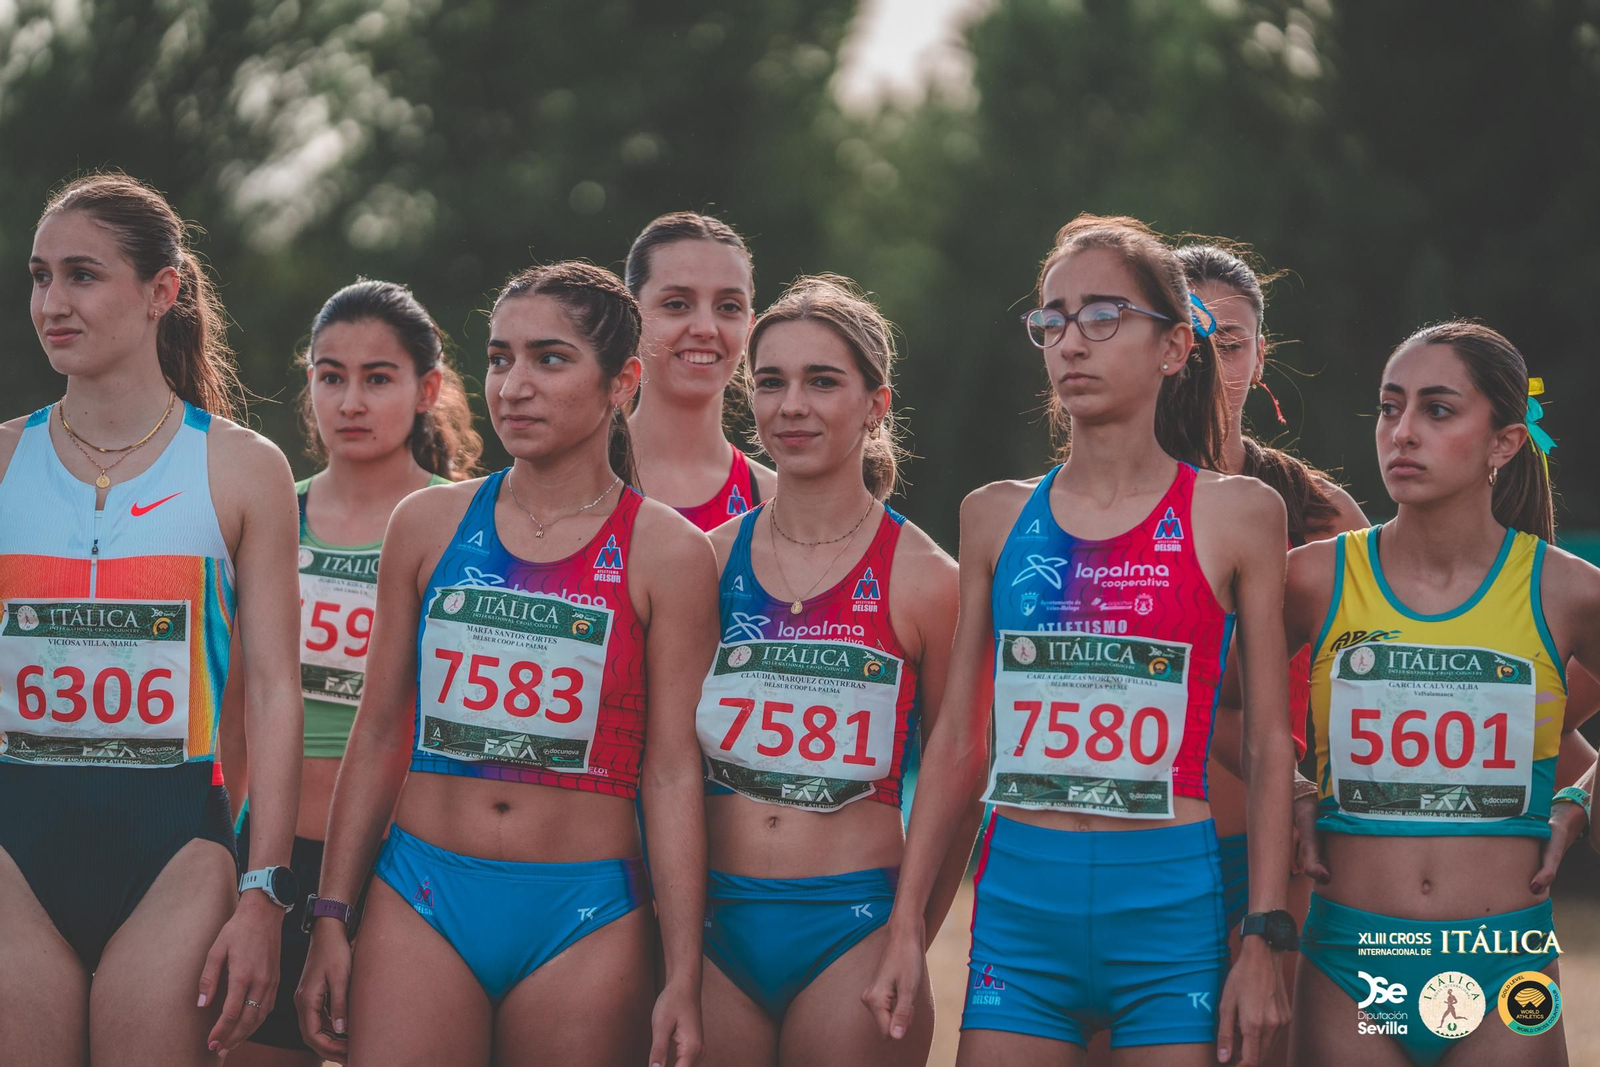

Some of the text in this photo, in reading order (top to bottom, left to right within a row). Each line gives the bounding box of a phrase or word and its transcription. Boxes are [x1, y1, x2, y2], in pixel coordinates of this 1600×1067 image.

[594, 574, 621, 583] DELSUR
[1075, 561, 1170, 584] lapalma
[1101, 578, 1170, 590] cooperativa
[50, 605, 139, 628] ITÁLICA
[475, 594, 559, 624] ITÁLICA
[852, 604, 878, 612] DELSUR
[300, 599, 374, 657] 59
[466, 625, 558, 644] MARTA SANTOS CORTES
[778, 620, 864, 640] lapalma
[1037, 620, 1128, 634] ATLETISMO
[473, 634, 497, 643] DELSUR
[525, 643, 548, 651] PALMA
[1049, 638, 1135, 664] ITÁLICA
[762, 645, 850, 668] ITÁLICA
[1388, 649, 1482, 671] ITÁLICA
[435, 648, 584, 724] 7583
[740, 672, 867, 689] CLAUDIA MARQUEZ CONTRERAS
[764, 681, 790, 689] DELSUR
[1053, 673, 1087, 681] CABEZAS
[1088, 674, 1123, 684] MORENO
[1388, 681, 1421, 689] GARCÍA
[16, 665, 174, 724] 6306
[719, 697, 876, 766] 7581
[1013, 701, 1169, 765] 7580
[1350, 709, 1516, 769] 5601
[972, 995, 1001, 1005] DELSUR
